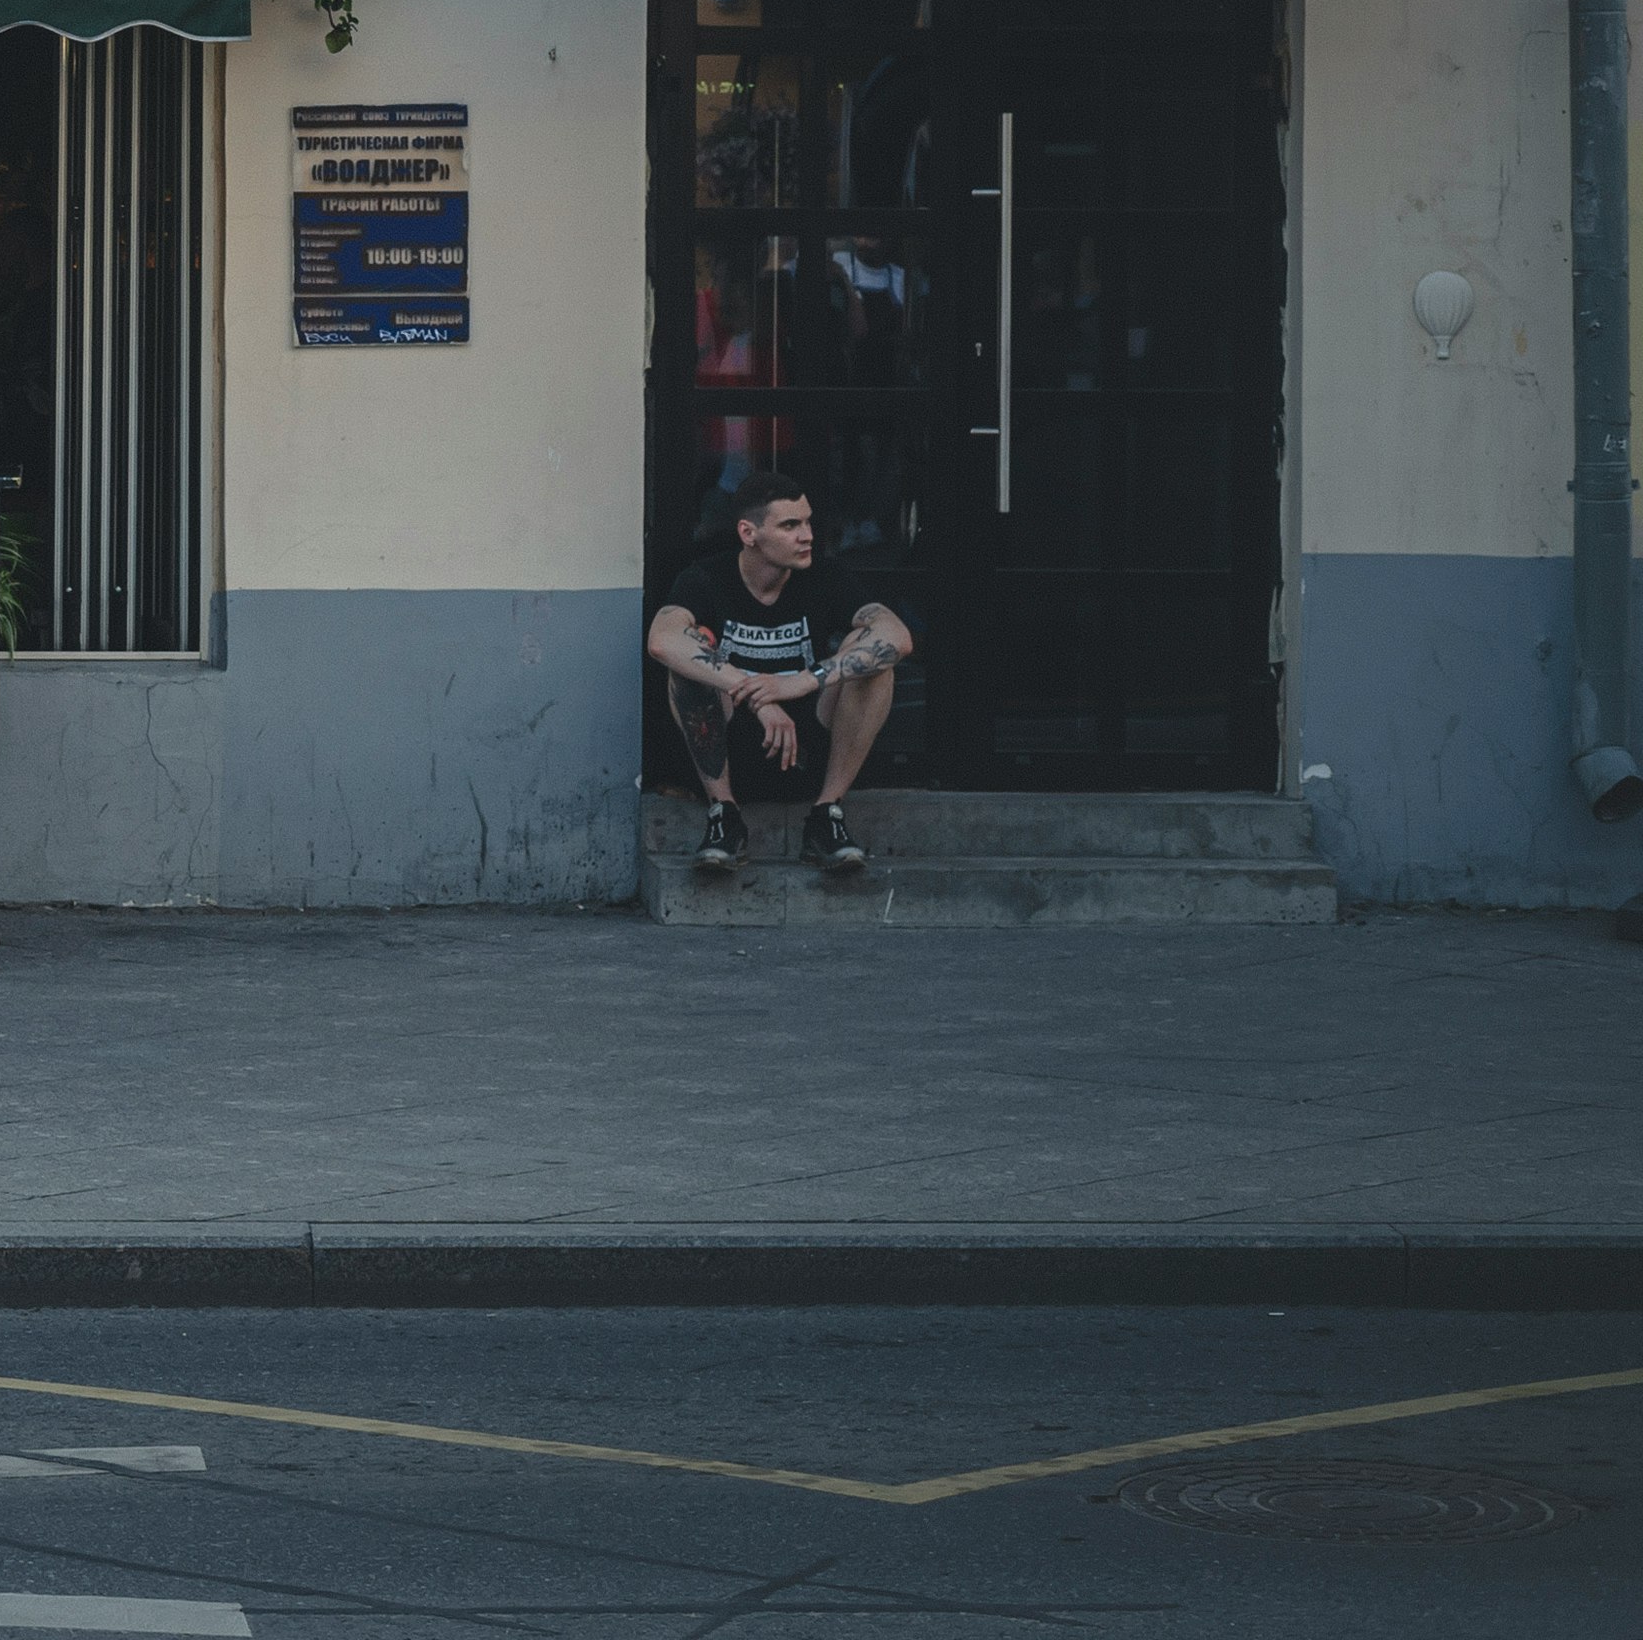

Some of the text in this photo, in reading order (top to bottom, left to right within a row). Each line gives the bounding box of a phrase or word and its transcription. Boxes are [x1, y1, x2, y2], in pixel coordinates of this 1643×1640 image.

[297, 136, 464, 150] ТУРИСТИЧЕСКАЯ ФИРМА
[322, 198, 440, 211] ГРАФИК РАБОТЫ
[367, 247, 463, 264] 10:00-19:00
[395, 313, 463, 326] Выходной
